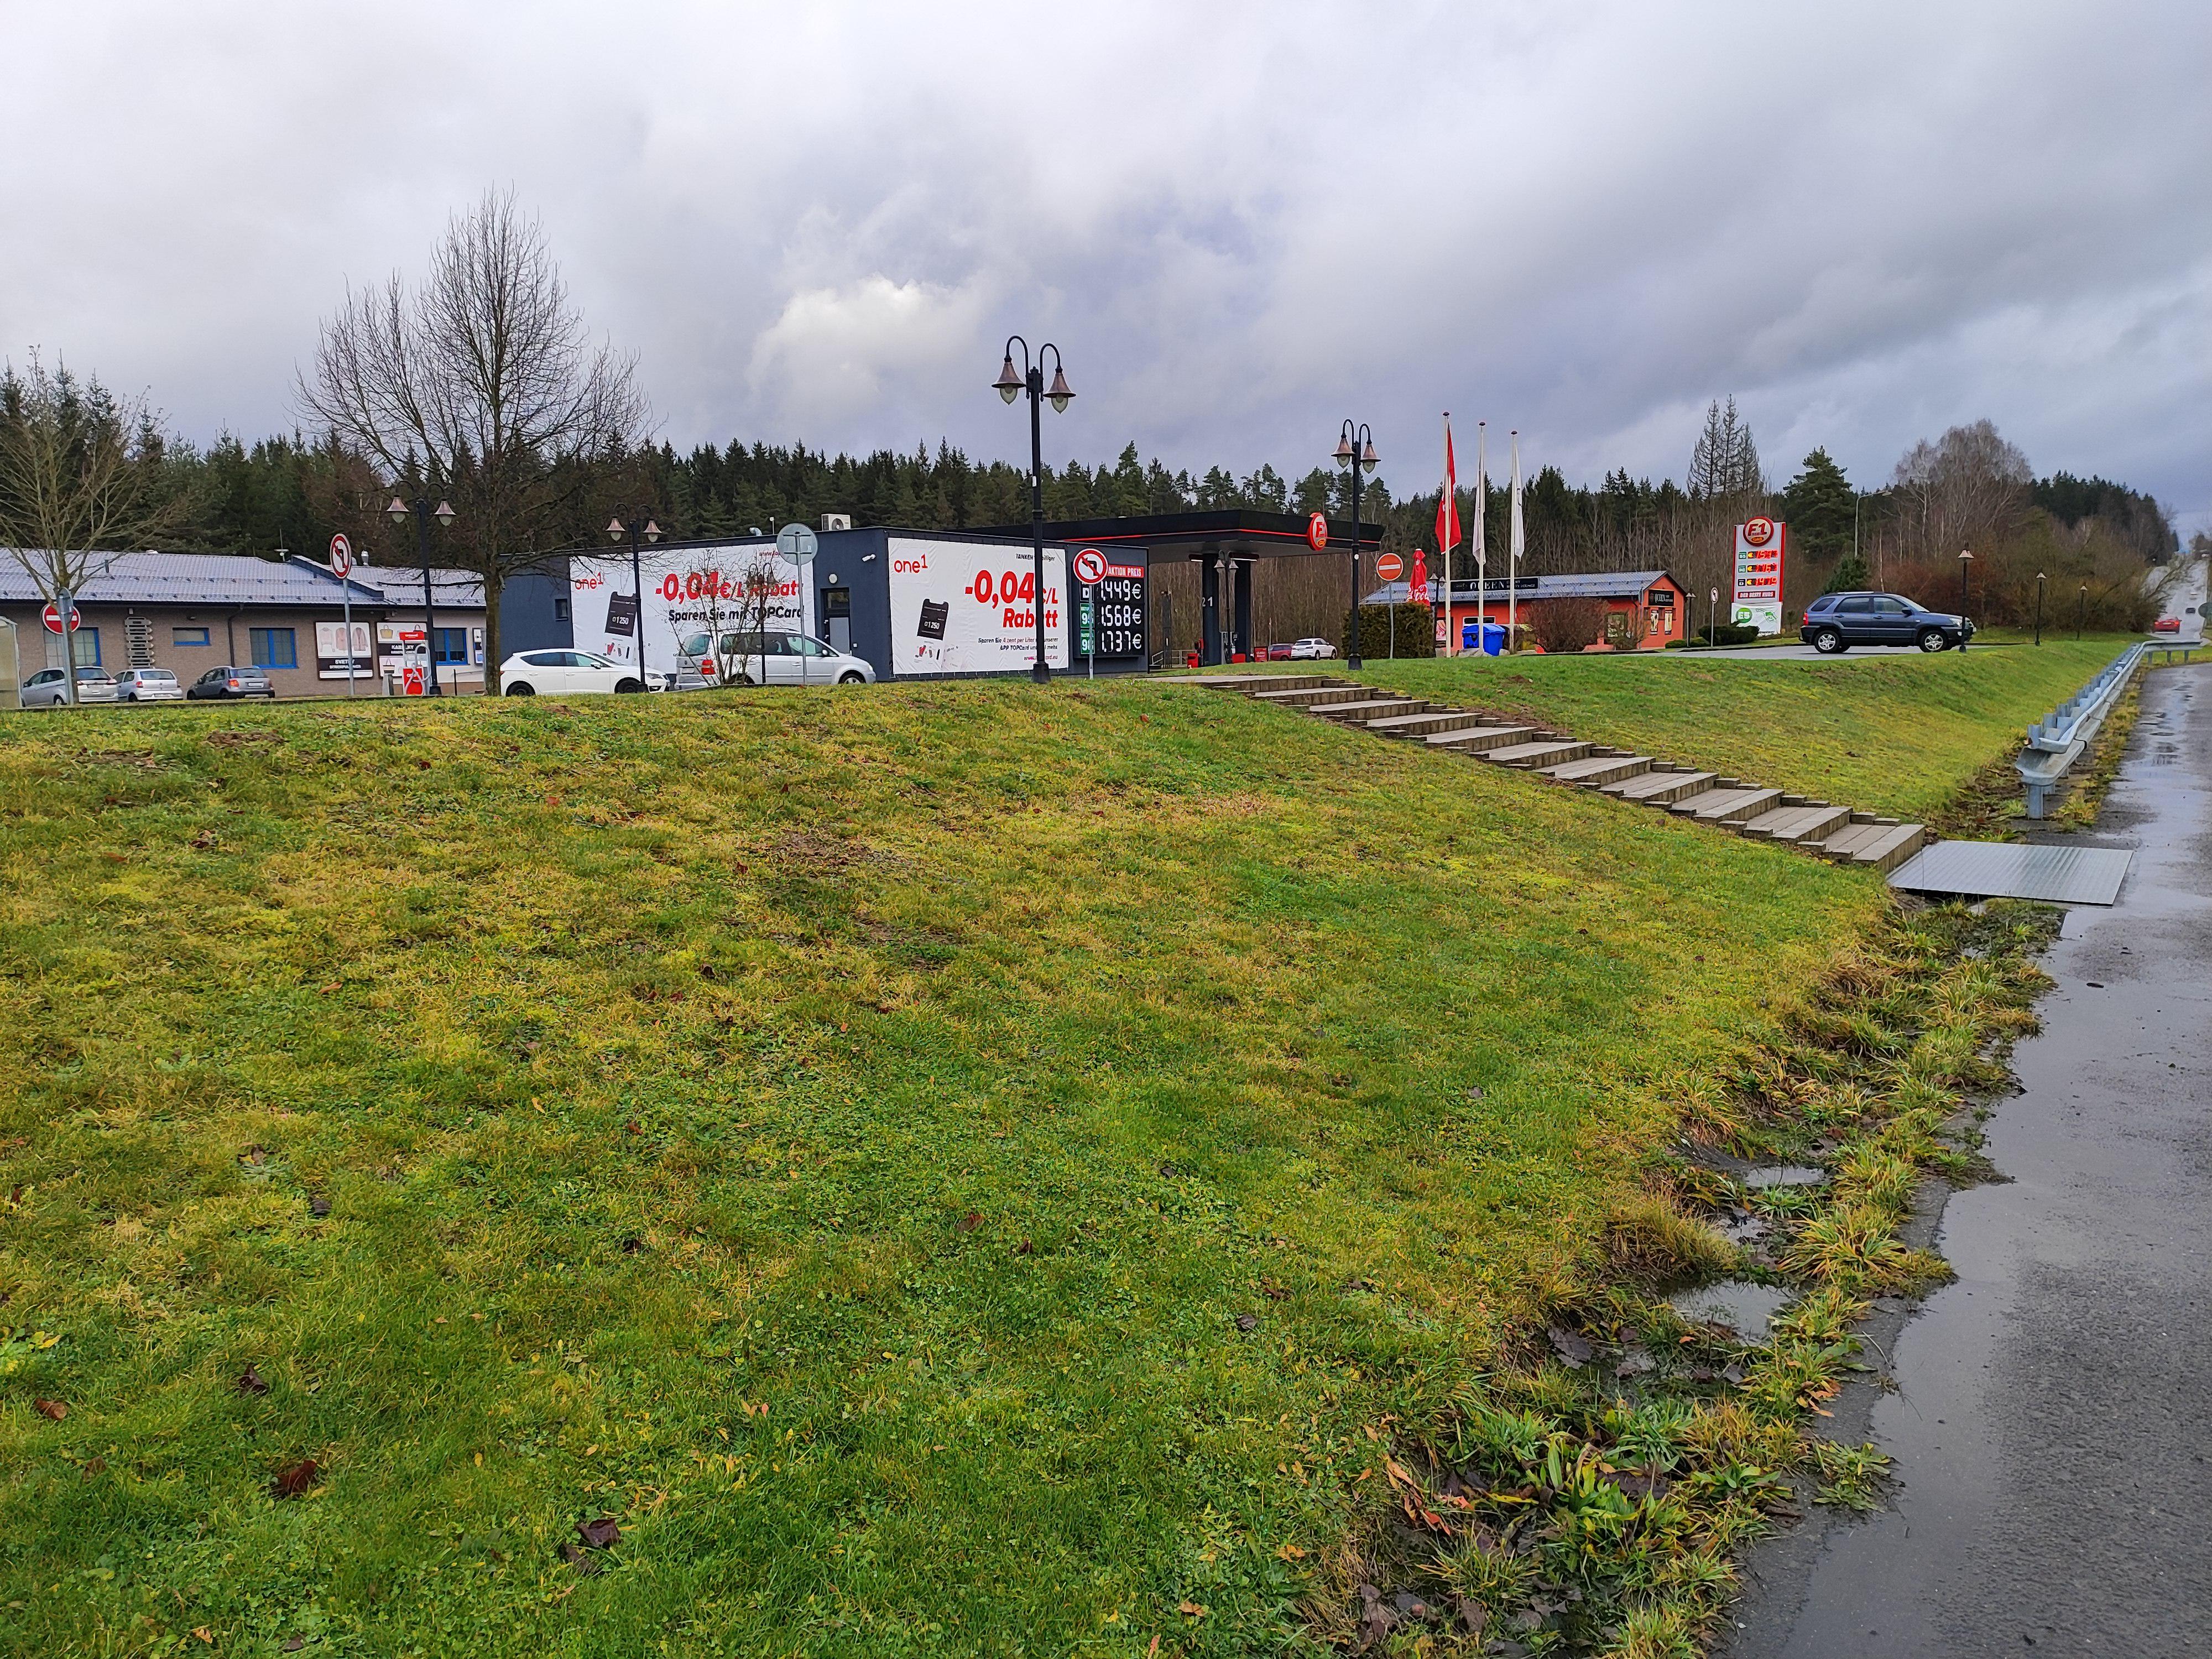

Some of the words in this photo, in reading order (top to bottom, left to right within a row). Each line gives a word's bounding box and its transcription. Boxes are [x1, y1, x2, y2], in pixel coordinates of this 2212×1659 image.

[1748, 523, 1767, 536] F1
[1108, 567, 1126, 575] AKTION
[1127, 568, 1141, 577] PREIS
[1470, 582, 1505, 591] QEEN
[1003, 608, 1058, 628] Rabtt
